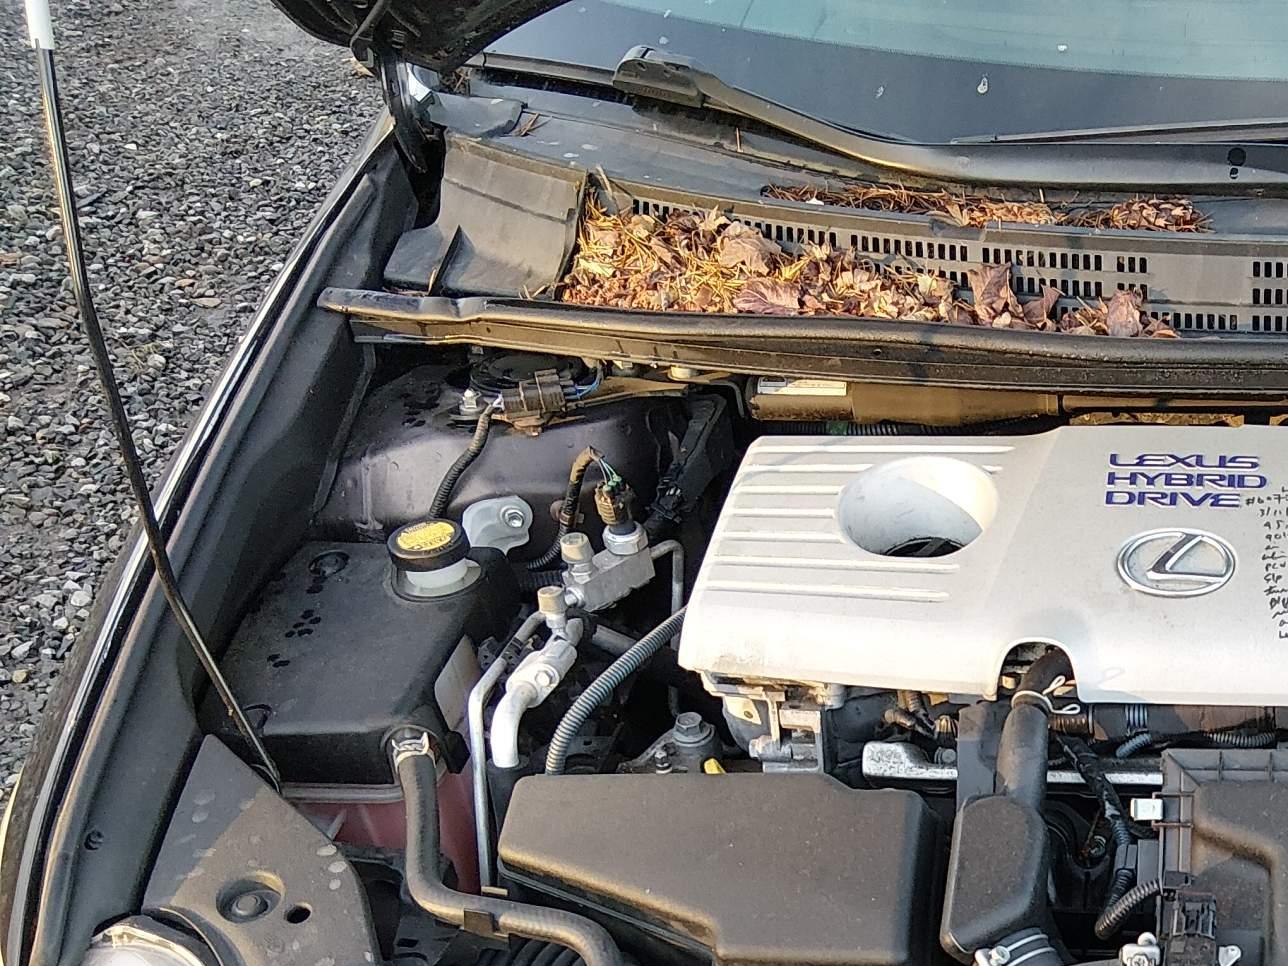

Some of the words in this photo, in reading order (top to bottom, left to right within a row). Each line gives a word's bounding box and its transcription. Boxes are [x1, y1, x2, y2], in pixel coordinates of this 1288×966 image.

[1109, 453, 1260, 469] LEXUS
[1106, 471, 1267, 488] HYBRID
[1105, 491, 1241, 507] DRIVE
